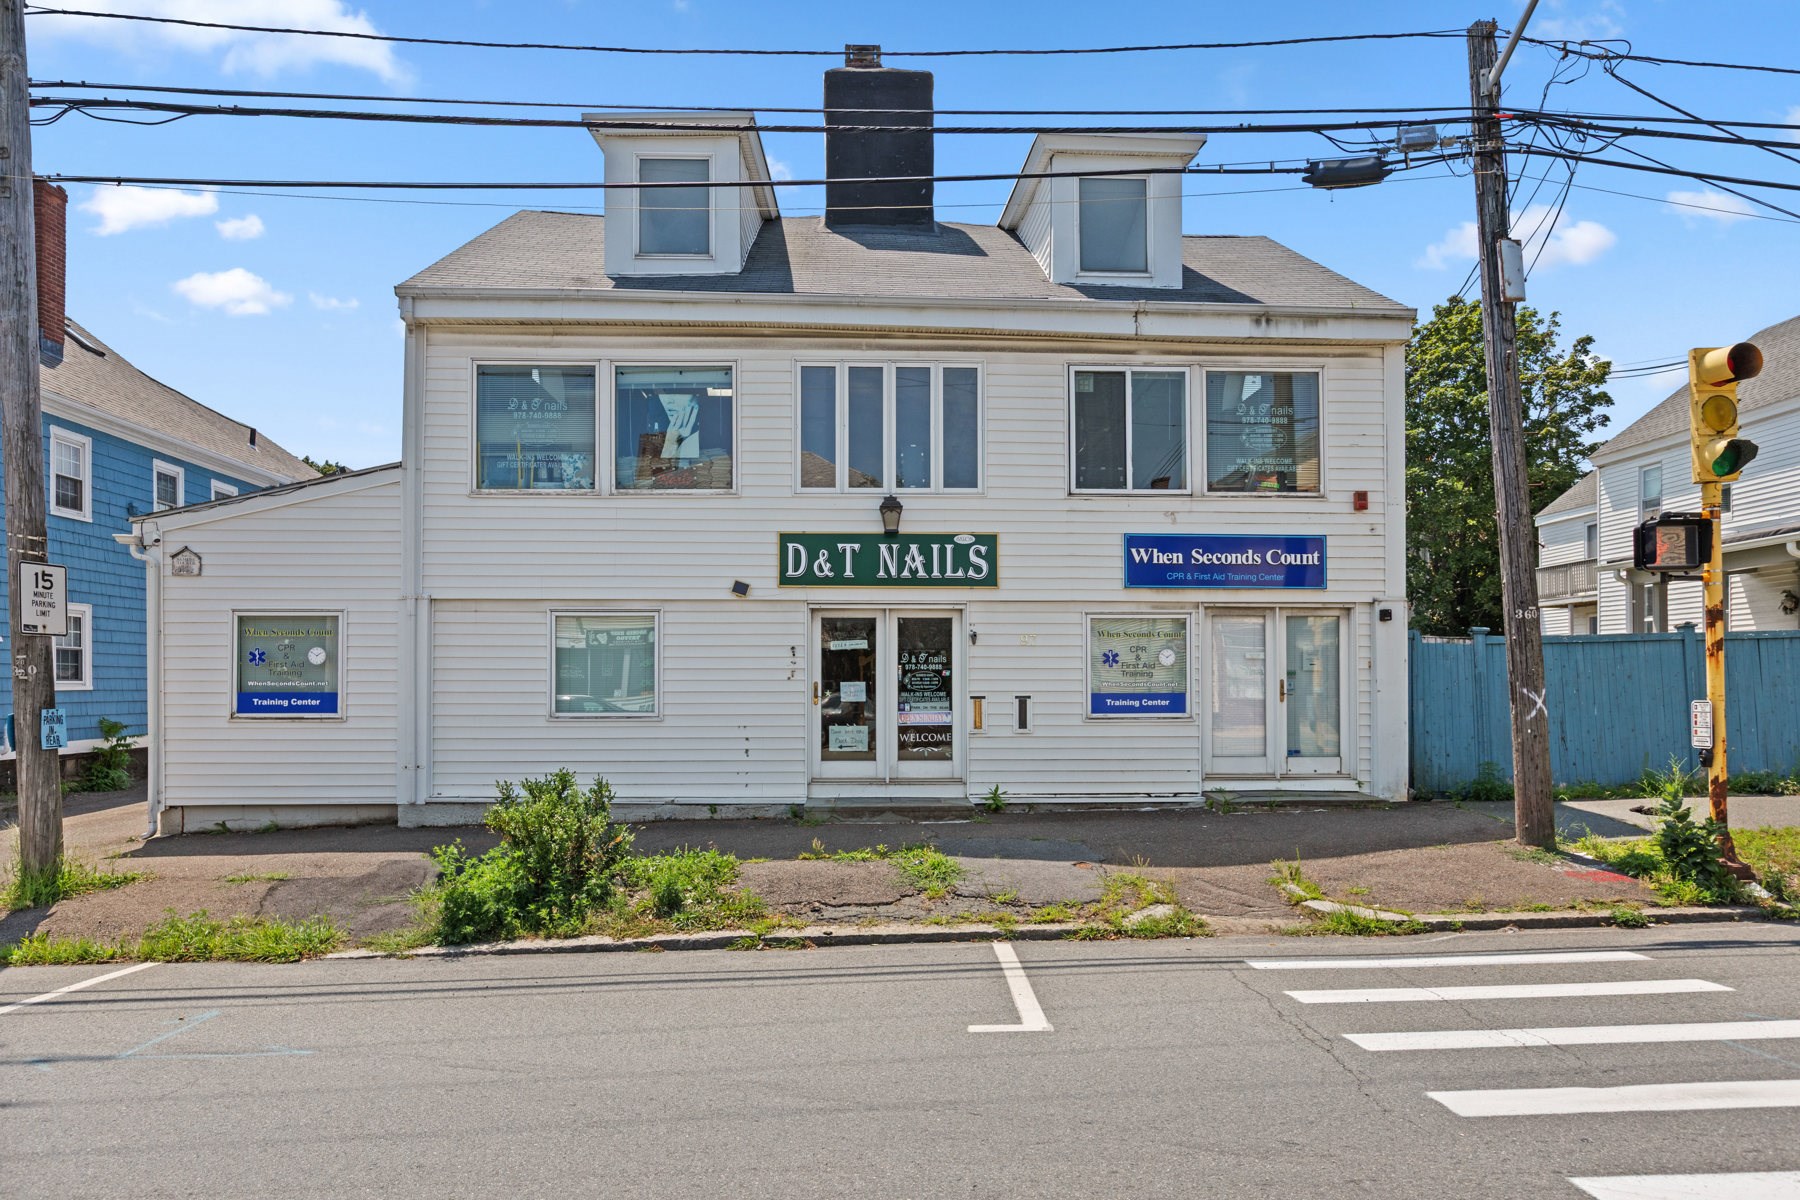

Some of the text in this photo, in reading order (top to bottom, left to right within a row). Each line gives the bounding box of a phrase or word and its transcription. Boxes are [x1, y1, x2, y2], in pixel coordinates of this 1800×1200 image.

[521, 401, 528, 410] &
[544, 400, 568, 410] nails
[1249, 406, 1256, 415] &
[1271, 405, 1294, 415] nails
[1241, 416, 1288, 424] 978-740-9888
[876, 543, 989, 580] NAILS
[1130, 548, 1321, 566] When Seconds Count
[34, 569, 54, 590] 15
[1166, 572, 1286, 583] CPR & First Aid Training Center
[33, 590, 54, 600] MINUTE
[31, 599, 56, 609] PARKING
[35, 609, 51, 618] LIMIT
[244, 627, 334, 637] When Seconds Count
[1097, 630, 1184, 638] When Seconds Count
[277, 644, 296, 652] CPR
[1129, 645, 1147, 653] CPR
[928, 655, 947, 663] nails
[1121, 662, 1156, 670] First Aid
[269, 669, 303, 678] Training
[1121, 670, 1154, 679] Training
[252, 698, 321, 707] Training Center
[1105, 699, 1140, 707] Training
[43, 714, 64, 725] PARKING
[899, 733, 953, 742] WELCOME
